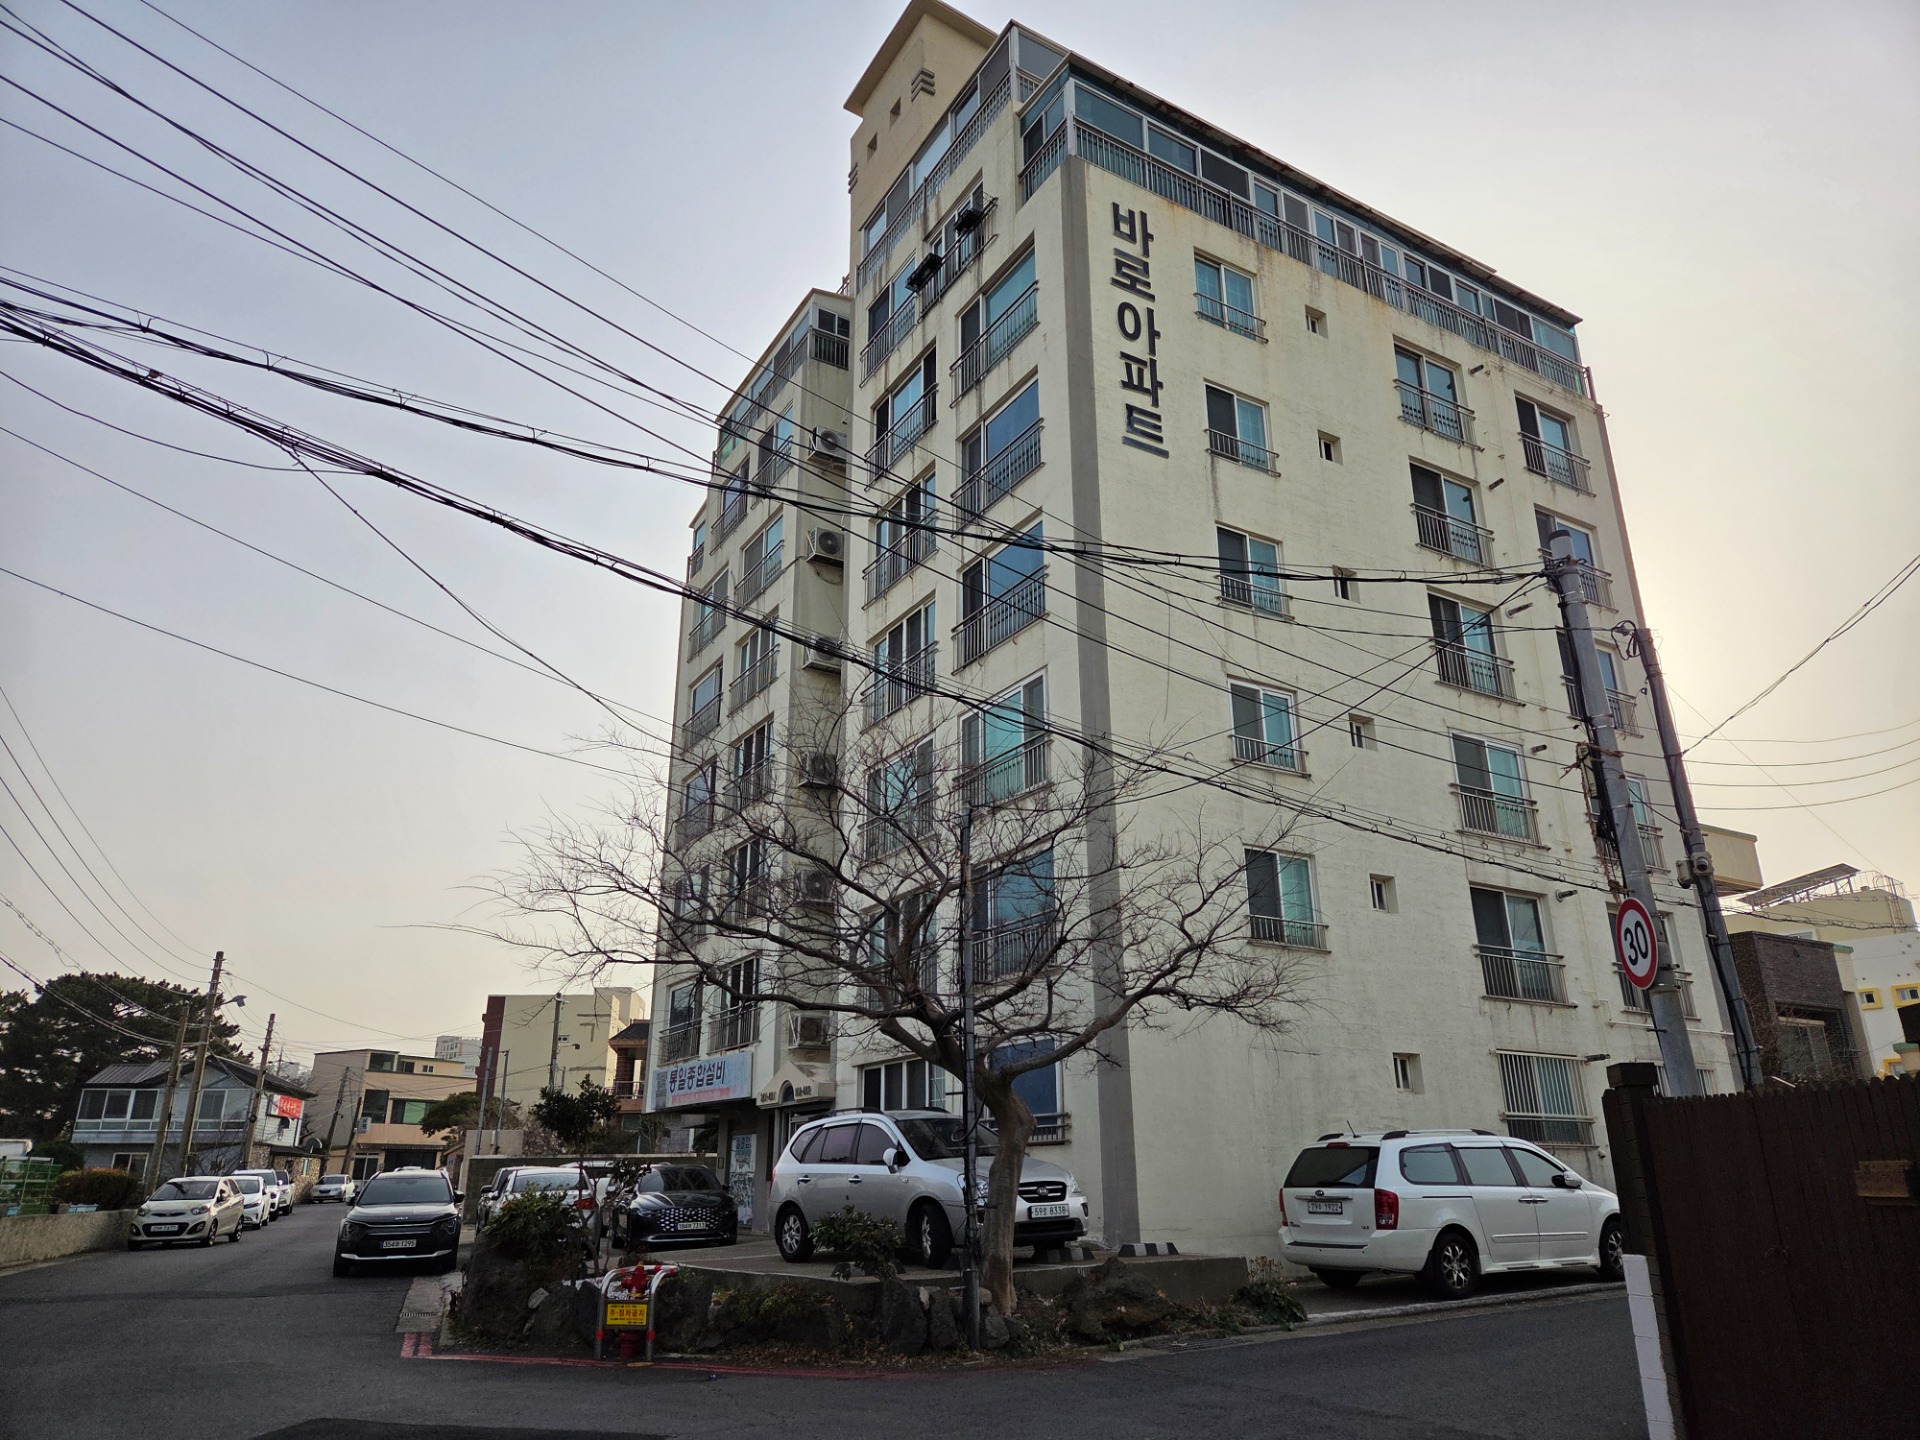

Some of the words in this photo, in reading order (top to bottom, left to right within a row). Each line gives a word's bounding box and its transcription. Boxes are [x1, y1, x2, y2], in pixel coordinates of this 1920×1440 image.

[1110, 201, 1170, 459] 바로아파트
[1623, 920, 1649, 966] 30
[669, 1060, 726, 1093] 통일종합설비
